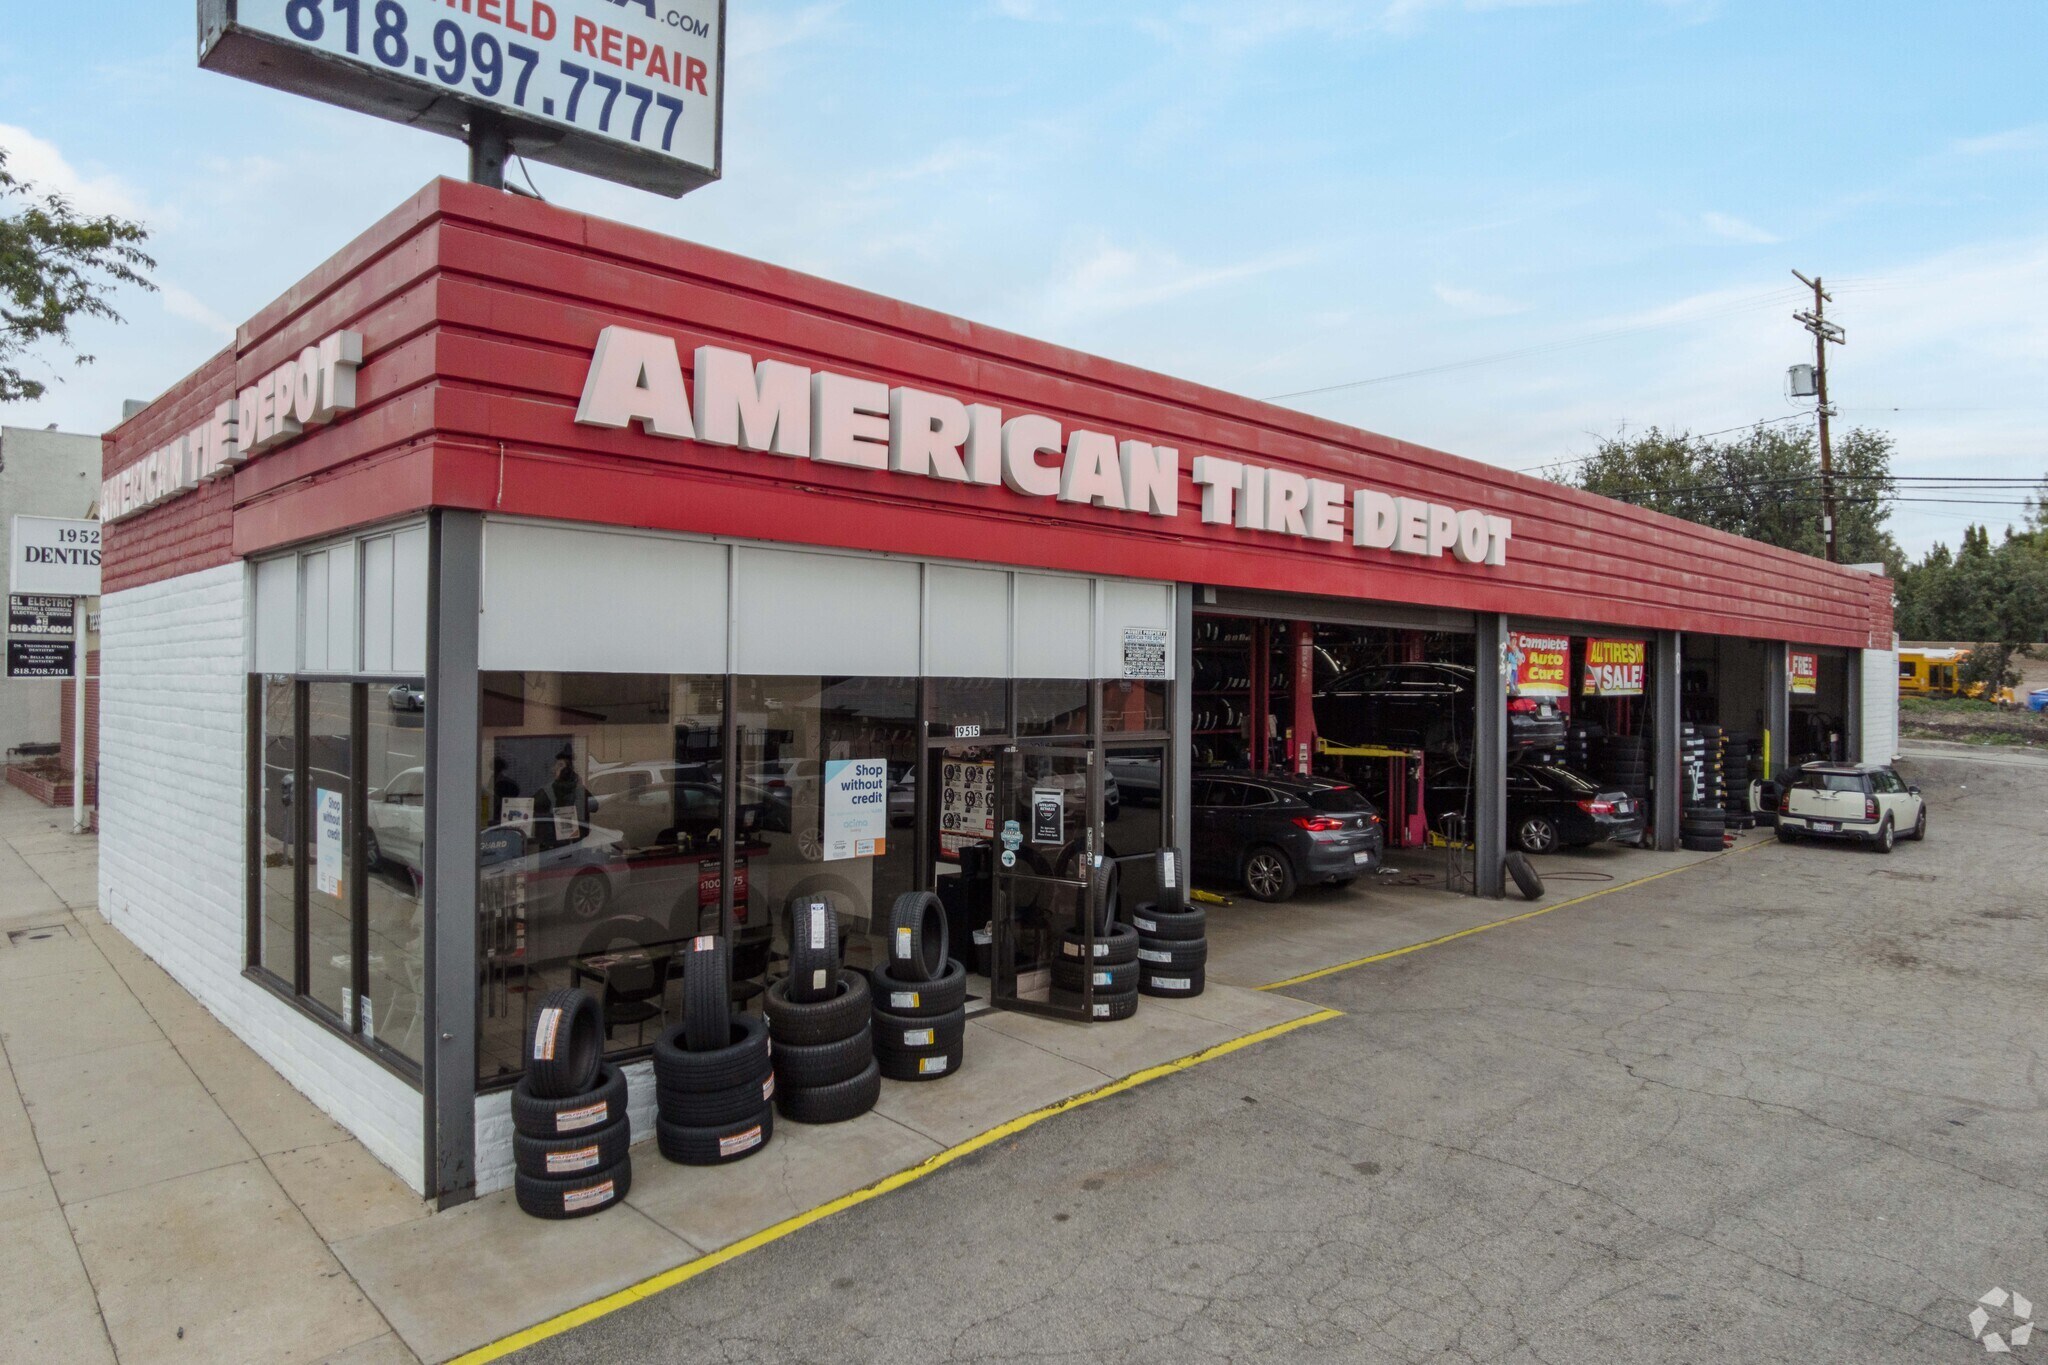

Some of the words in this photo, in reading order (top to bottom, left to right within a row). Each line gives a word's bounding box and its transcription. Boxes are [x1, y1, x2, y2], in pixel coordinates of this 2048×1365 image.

[431, 0, 557, 41] ELD
[573, 15, 709, 96] REPAIR
[286, 0, 684, 152] 818.997.7777
[237, 329, 363, 452] DEPOT
[574, 325, 1180, 517] AMERICAN
[1192, 454, 1345, 542] TIRE
[1353, 488, 1512, 566] DEPOT
[59, 529, 100, 544] 1952
[11, 596, 23, 606] EL
[28, 597, 73, 608] ELECTRIC
[10, 624, 73, 634] 818-907-0044
[1520, 635, 1568, 650] Complete
[1530, 652, 1563, 665] Auto
[1604, 642, 1636, 664] TIRES
[1792, 655, 1812, 675] FREE
[1528, 666, 1564, 680] Care
[1603, 664, 1643, 690] SALE!
[956, 726, 979, 736] 19515
[856, 764, 882, 777] Shop
[841, 779, 882, 791] without
[328, 797, 340, 812] Shop
[852, 792, 882, 804] credit
[322, 811, 340, 826] without
[843, 819, 868, 828] acima
[327, 828, 340, 841] credit
[701, 879, 721, 891] $100
